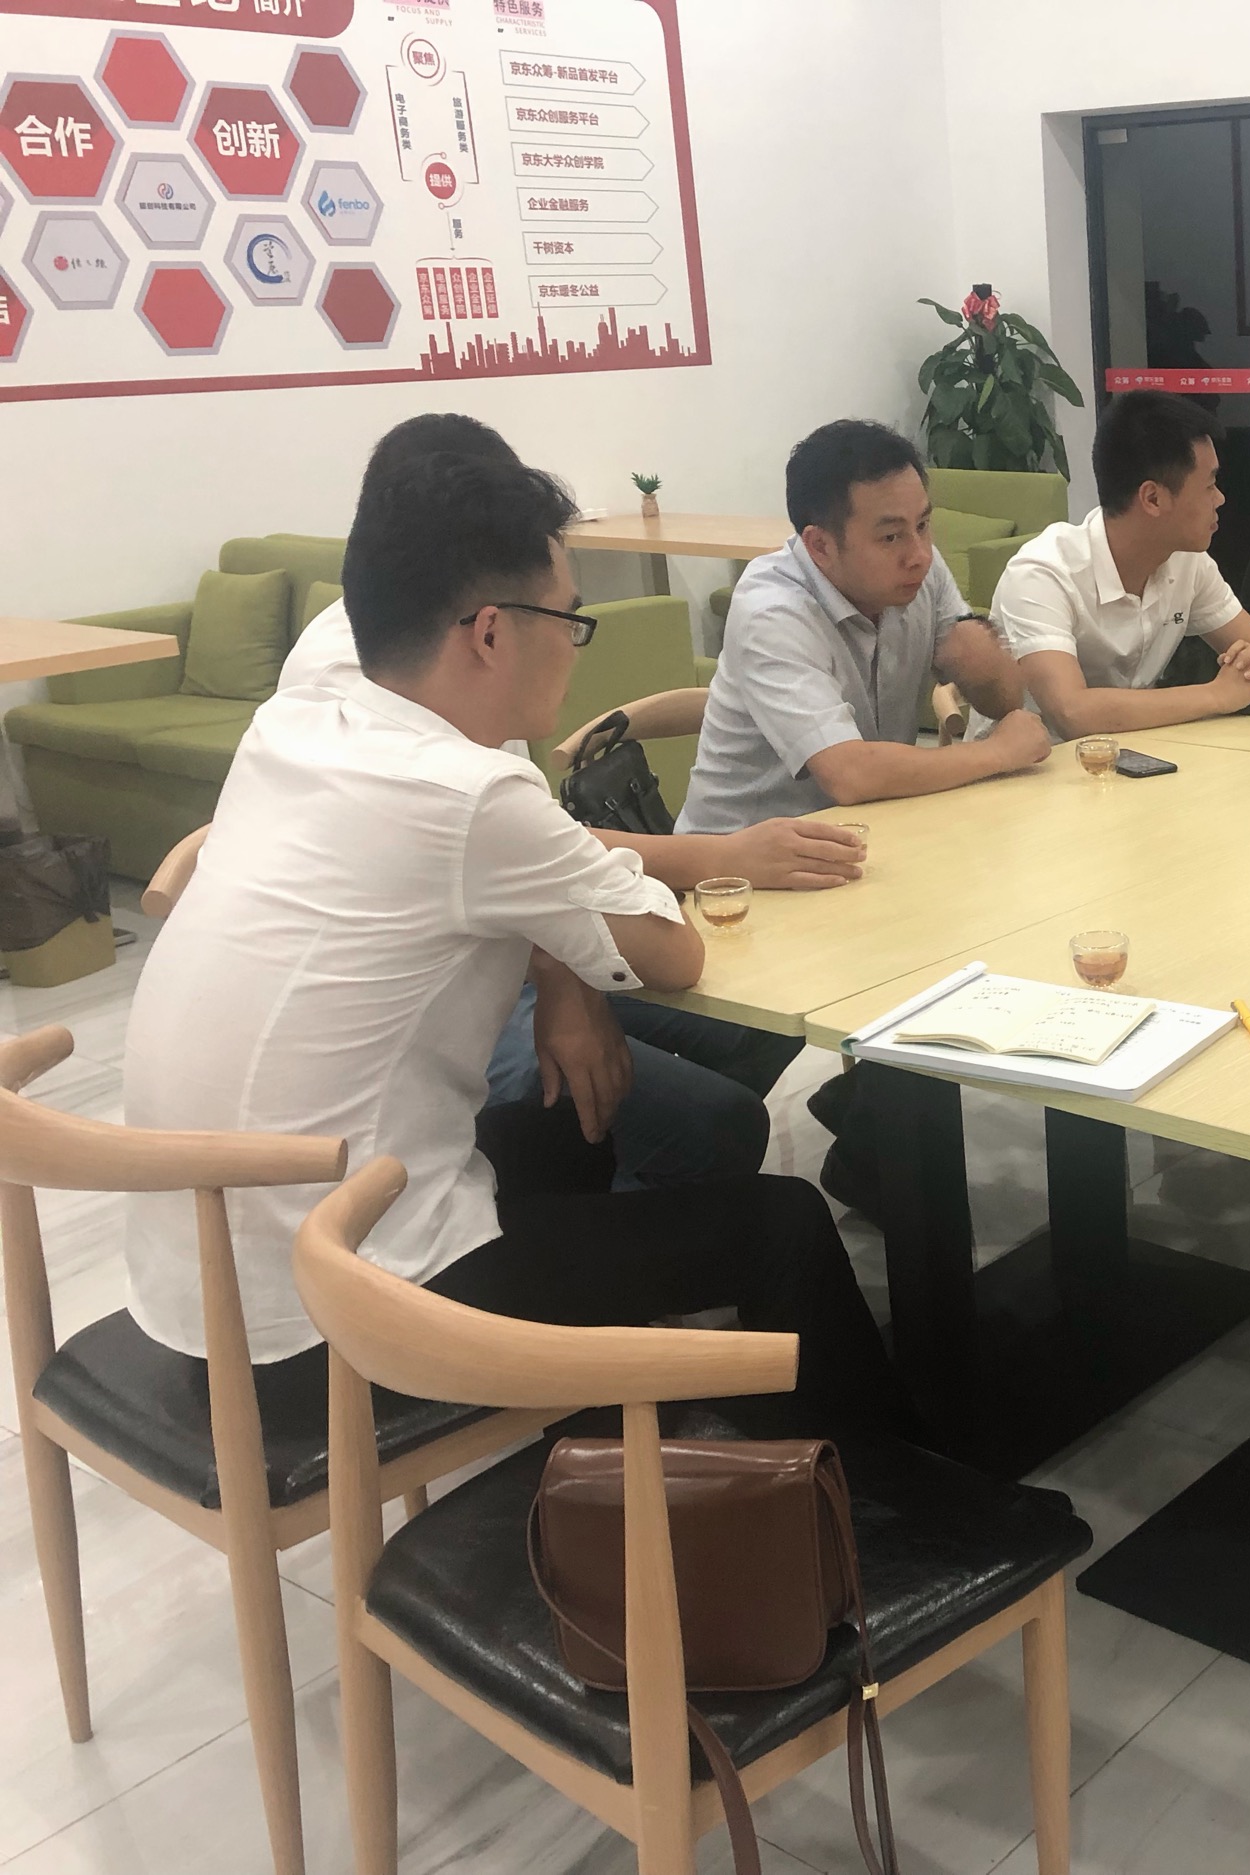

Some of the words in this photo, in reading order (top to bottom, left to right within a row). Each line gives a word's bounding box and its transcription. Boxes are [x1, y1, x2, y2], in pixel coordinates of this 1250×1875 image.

[396, 5, 421, 14] FOCUS
[493, 0, 543, 17] 特色服务
[425, 17, 452, 26] SUPPLY
[412, 51, 436, 66] 聚焦
[509, 61, 618, 84] 京东众筹-新品首发平台
[515, 107, 599, 126] 京东众创服务平台
[14, 114, 94, 158] 合作
[212, 118, 281, 159] 创新
[521, 152, 605, 170] 京东大学众创学院
[429, 173, 453, 187] 提供
[338, 198, 370, 210] fenbo
[527, 197, 589, 212] 企业金融服务
[538, 284, 600, 298] 京东暖冬公益
